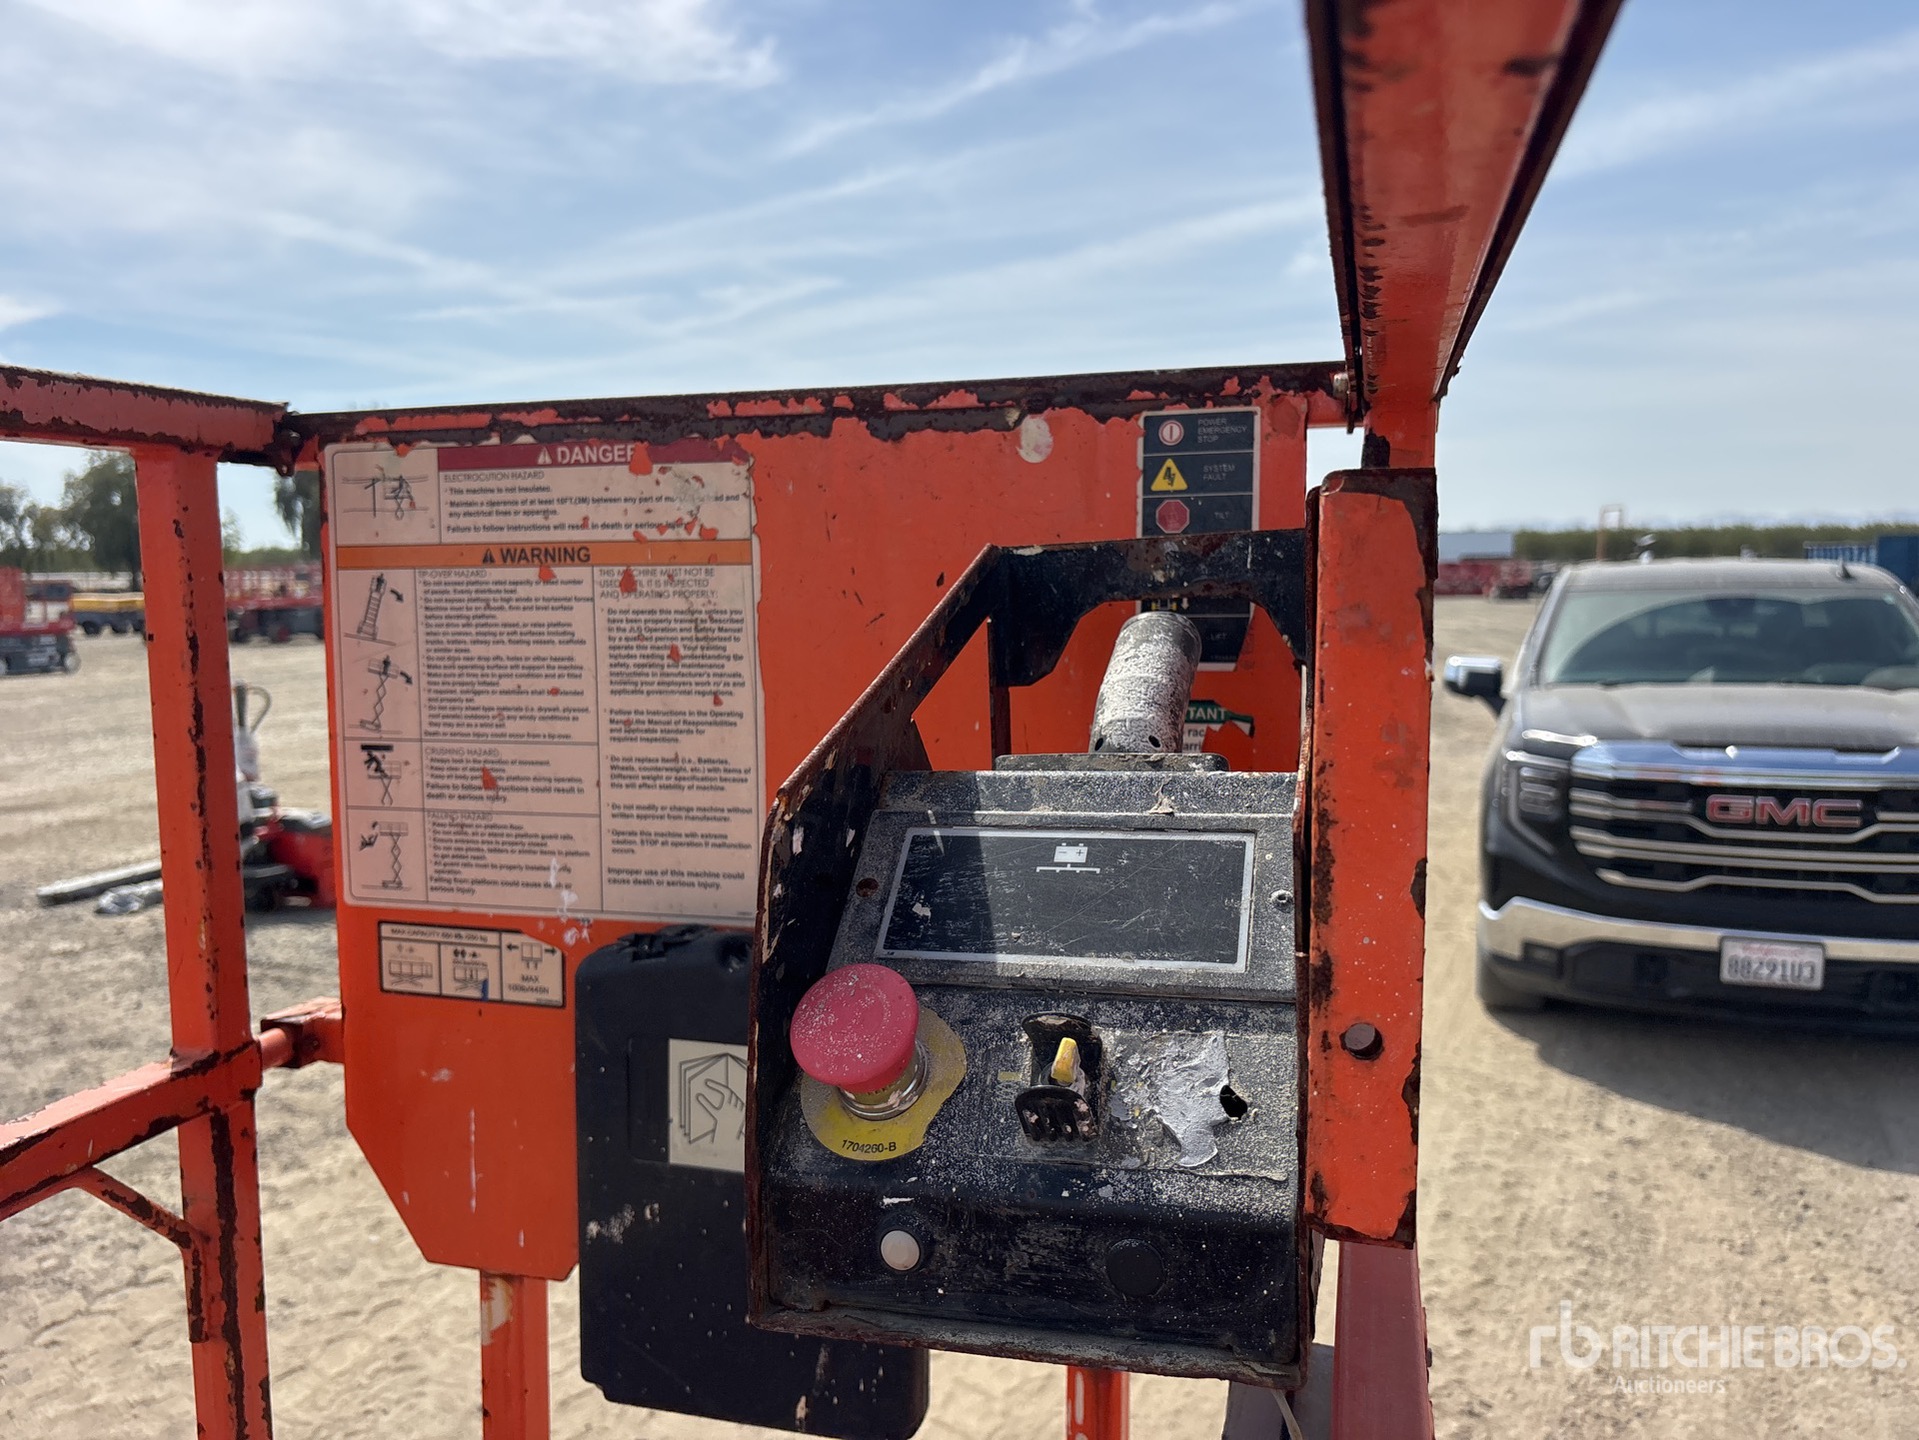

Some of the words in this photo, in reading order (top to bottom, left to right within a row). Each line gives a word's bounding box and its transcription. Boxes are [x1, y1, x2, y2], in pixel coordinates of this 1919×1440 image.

[1198, 418, 1227, 426] POWER
[1198, 426, 1247, 434] EMERGENCY
[1197, 435, 1219, 443] STOP
[1203, 464, 1236, 472] SYSTEM
[444, 473, 510, 483] ELECTROCUTION
[510, 472, 544, 481] HAZARD
[1203, 473, 1227, 481] FAULT
[501, 546, 591, 564] WARNING
[599, 569, 614, 577] THIS
[617, 569, 657, 577] MCHINE
[659, 568, 681, 577] MUST
[683, 568, 702, 576] NOT
[704, 568, 714, 576] BE
[1706, 794, 1862, 828] GMC
[841, 1139, 897, 1154] 1704260-B
